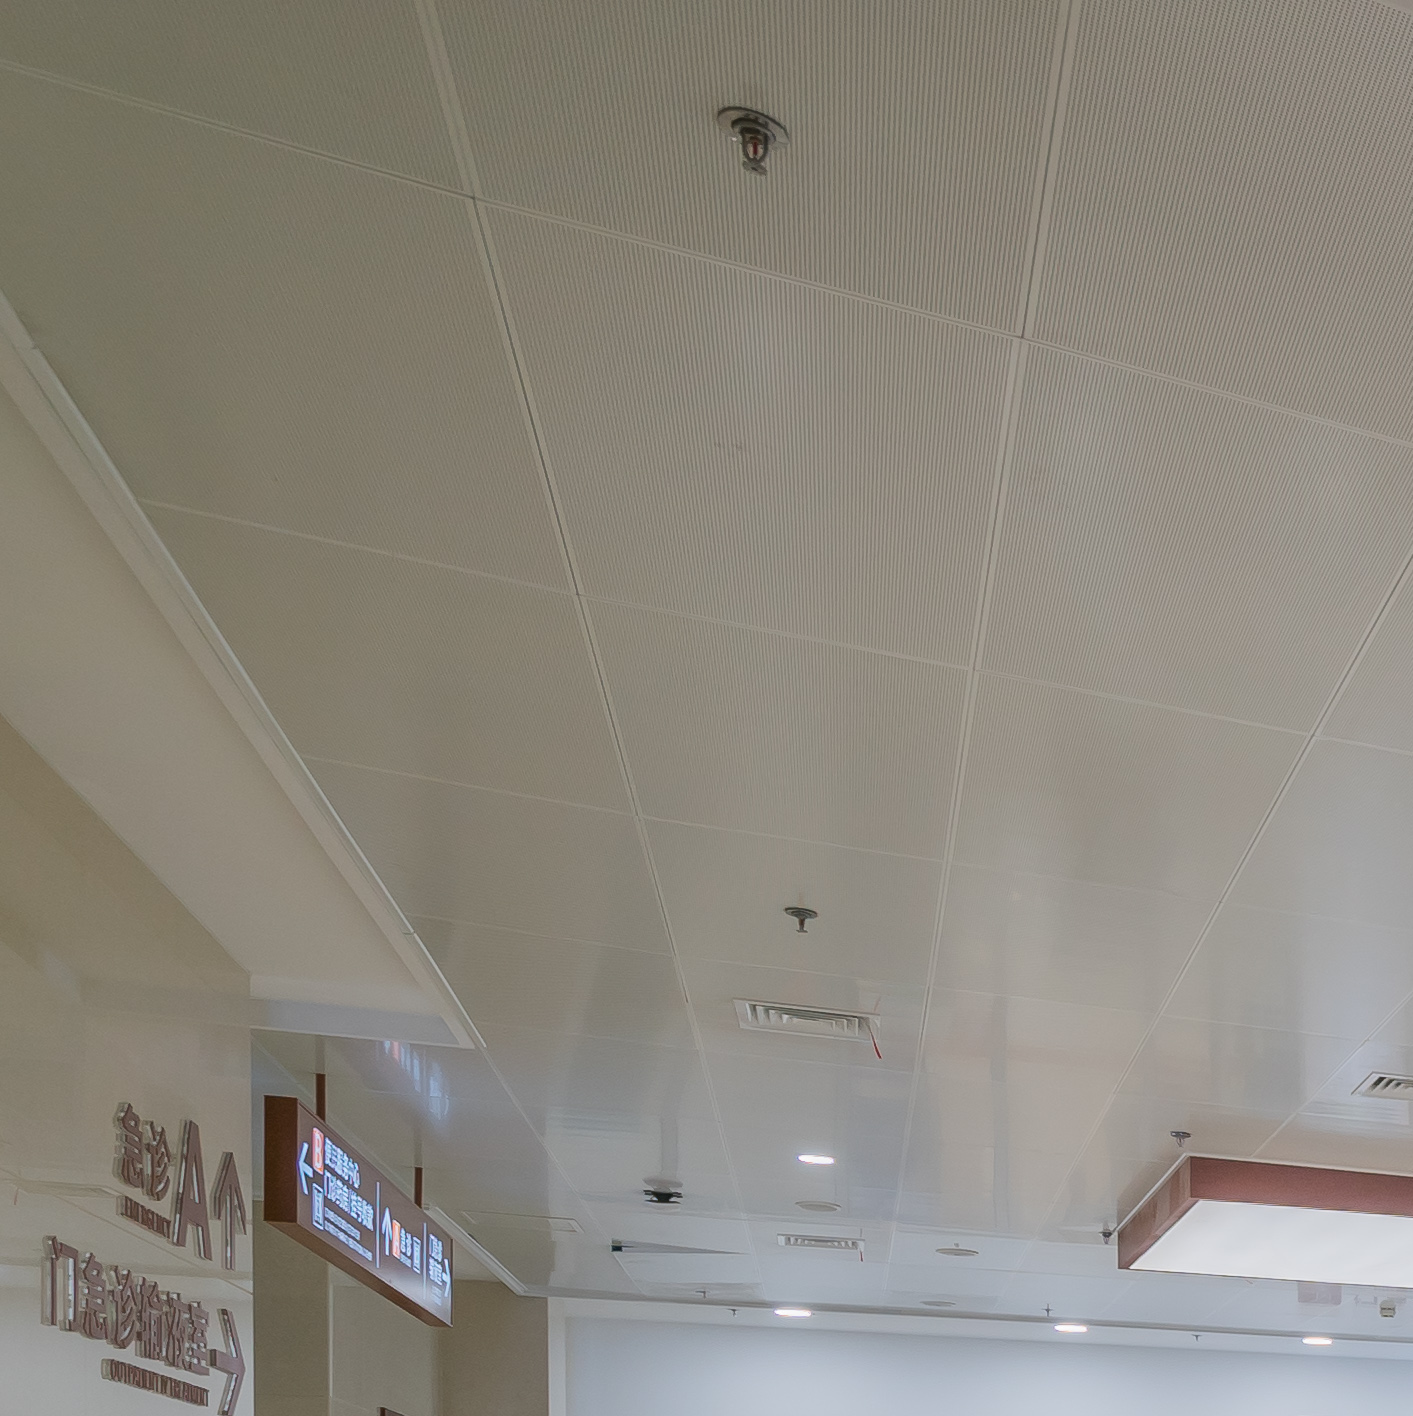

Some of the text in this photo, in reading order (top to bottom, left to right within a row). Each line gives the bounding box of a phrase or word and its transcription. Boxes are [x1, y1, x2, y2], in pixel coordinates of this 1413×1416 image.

[114, 1102, 213, 1261] 急诊 A
[41, 1235, 210, 1376] 门急诊输液室
